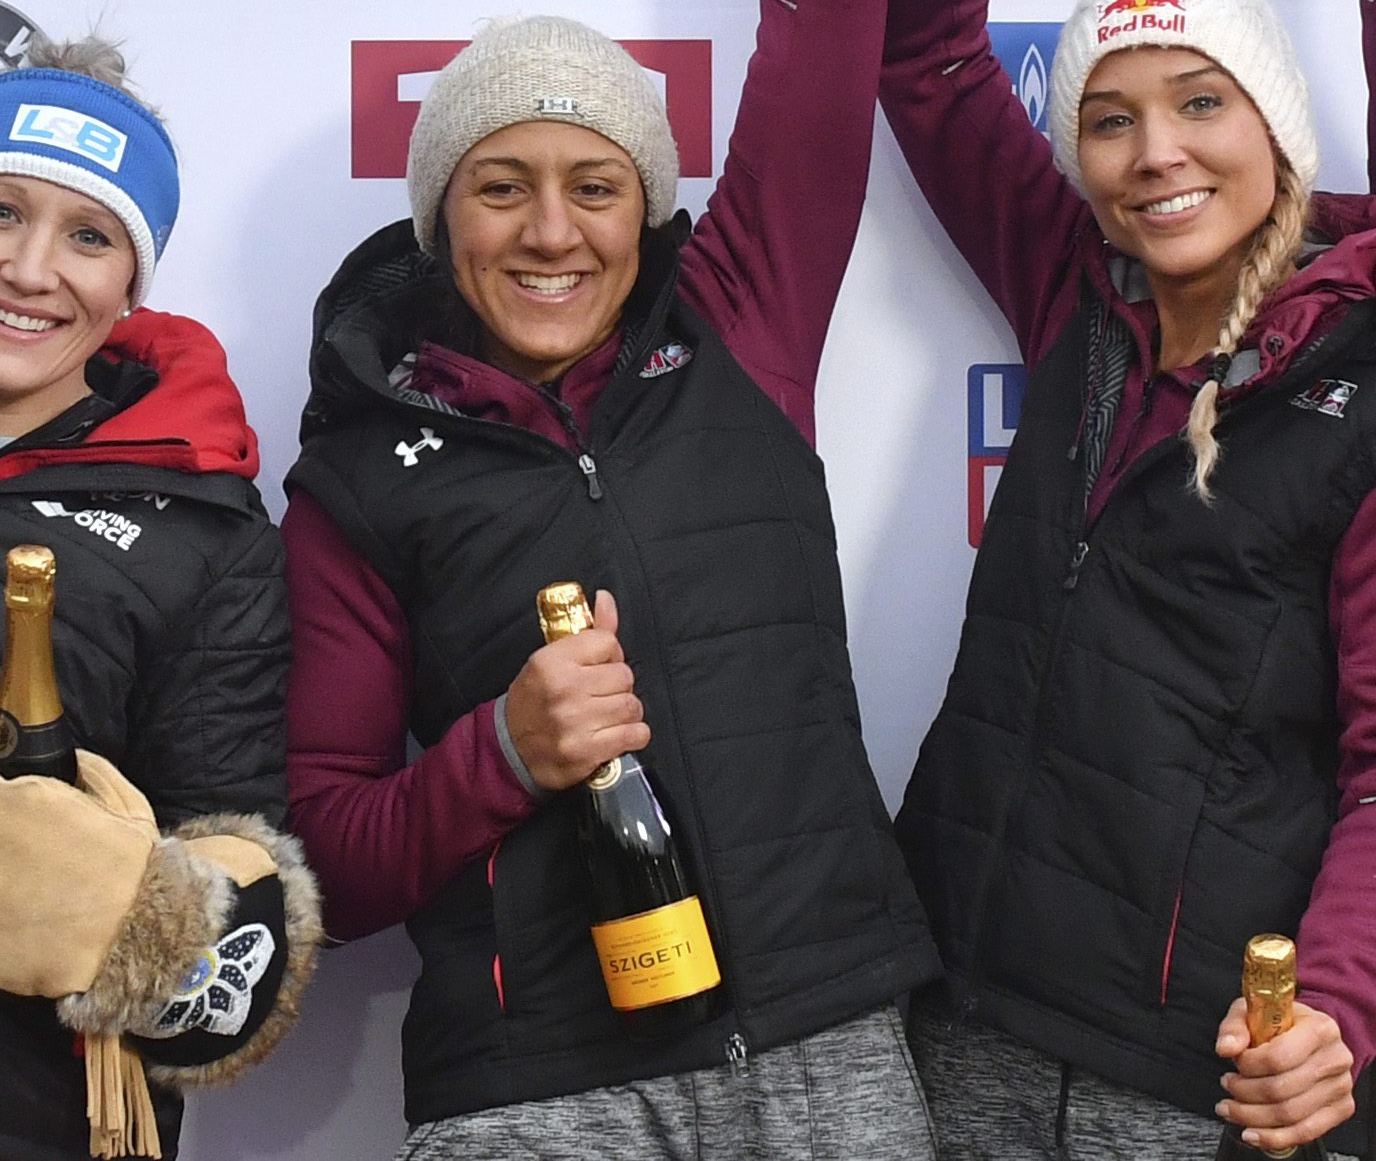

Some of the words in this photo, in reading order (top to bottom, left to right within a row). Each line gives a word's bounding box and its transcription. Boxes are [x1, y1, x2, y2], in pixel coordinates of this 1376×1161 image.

[1097, 14, 1138, 44] Red
[1141, 13, 1186, 34] Bull
[74, 512, 136, 551] ORCE
[609, 940, 692, 974] SZIGETI
